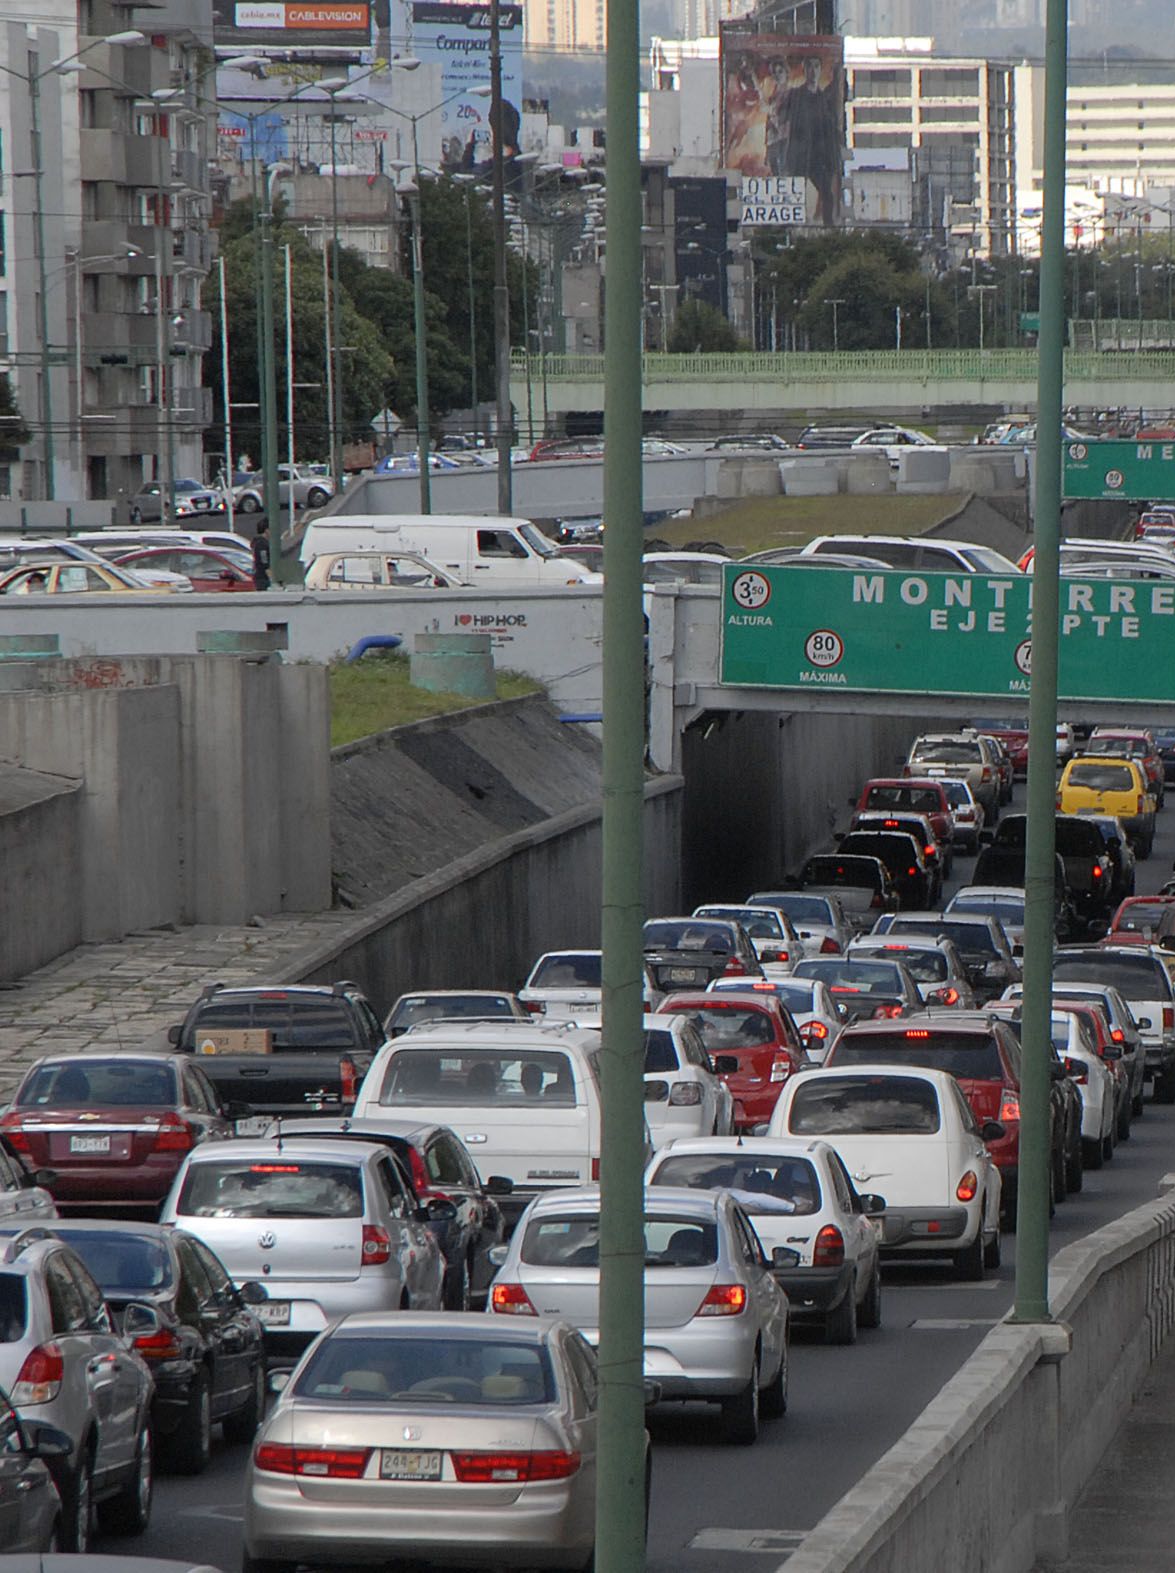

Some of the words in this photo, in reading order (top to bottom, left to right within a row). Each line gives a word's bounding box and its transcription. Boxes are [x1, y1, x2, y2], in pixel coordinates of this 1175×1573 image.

[289, 11, 361, 21] CABLEVISION
[743, 207, 803, 221] ARAGE
[474, 614, 495, 626] HIP
[496, 614, 526, 626] HOP
[728, 615, 773, 626] ALTURA
[930, 609, 1006, 633] EJE
[1062, 614, 1140, 638] PTE
[813, 635, 835, 651] 80
[813, 652, 834, 661] km/h
[800, 670, 847, 683] MÁXIMA
